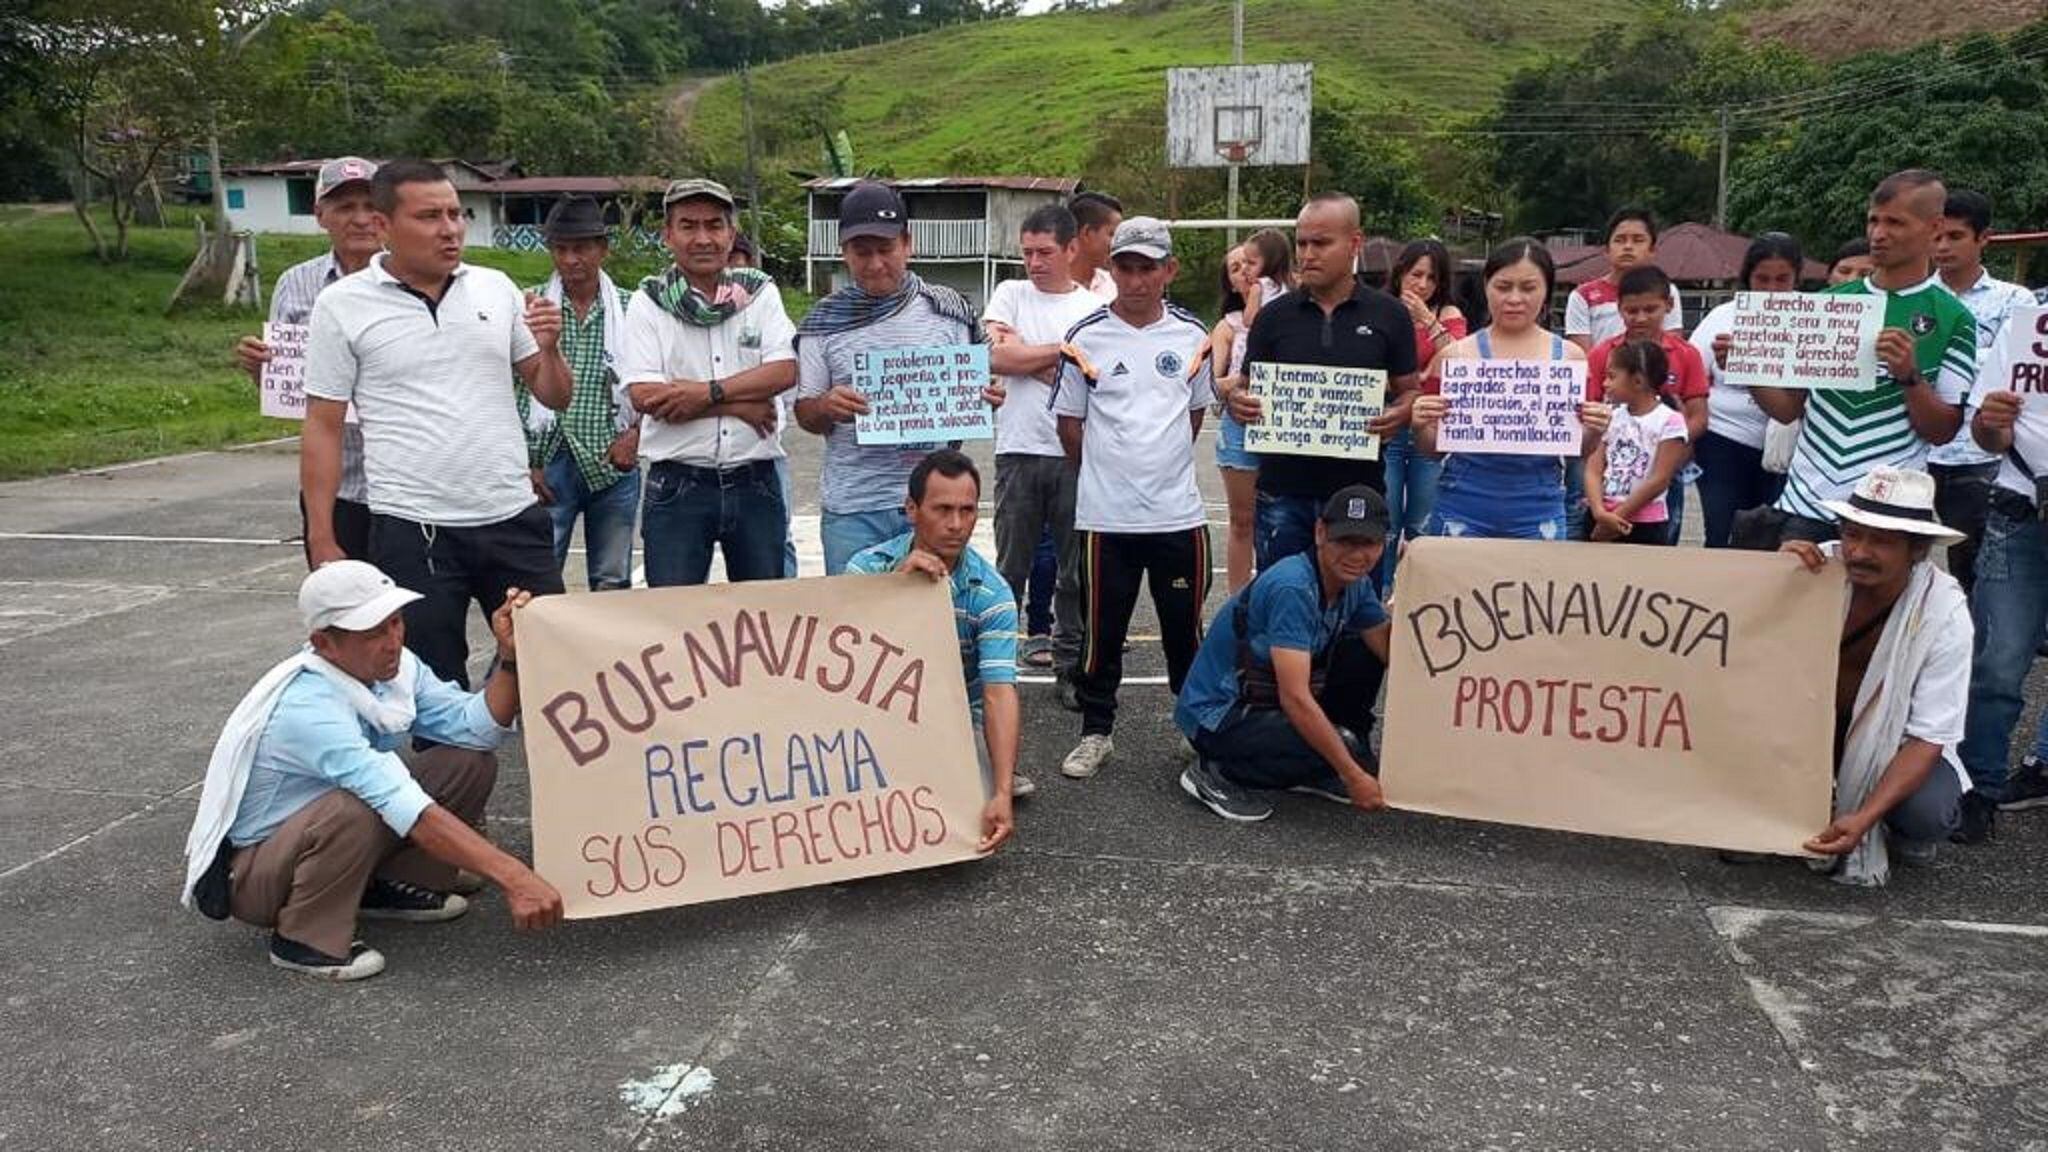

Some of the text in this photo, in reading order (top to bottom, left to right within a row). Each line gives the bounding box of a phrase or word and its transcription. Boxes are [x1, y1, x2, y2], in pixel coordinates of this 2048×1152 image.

[1738, 294, 1750, 310] El
[1764, 292, 1814, 312] derecho
[1828, 318, 1860, 334] muy
[1797, 332, 1826, 348] pero
[1836, 330, 1860, 350] hoy
[854, 350, 970, 372] El problema no
[1730, 344, 1856, 361] nuestros derechos
[856, 376, 872, 386] es
[940, 368, 950, 382] el
[1276, 365, 1327, 384] tenemos
[1445, 360, 1572, 379] Los derechos son
[906, 388, 921, 405] ya
[928, 386, 941, 396] es
[1272, 382, 1292, 400] hoy
[1298, 387, 1314, 399] no
[1320, 387, 1363, 401] vamos
[1443, 380, 1506, 397] sagrados
[1546, 384, 1560, 394] en
[1568, 380, 1580, 394] la
[936, 396, 947, 412] al
[1530, 398, 1542, 411] el
[858, 417, 871, 432] de
[874, 420, 896, 431] una
[900, 416, 934, 437] pronta
[1272, 414, 1282, 427] la
[1292, 413, 1326, 430] lucha
[1482, 412, 1538, 426] cansado
[1548, 413, 1565, 426] de
[1248, 428, 1370, 451] que venga arreglar
[1444, 426, 1484, 440] tanta
[1408, 580, 1730, 678] BUENAVISTA
[541, 608, 925, 767] BUENAVISTA
[1452, 674, 1694, 751] PROTESTA
[644, 728, 888, 819] RECLAMA
[581, 786, 948, 898] SUS DERECHOS
